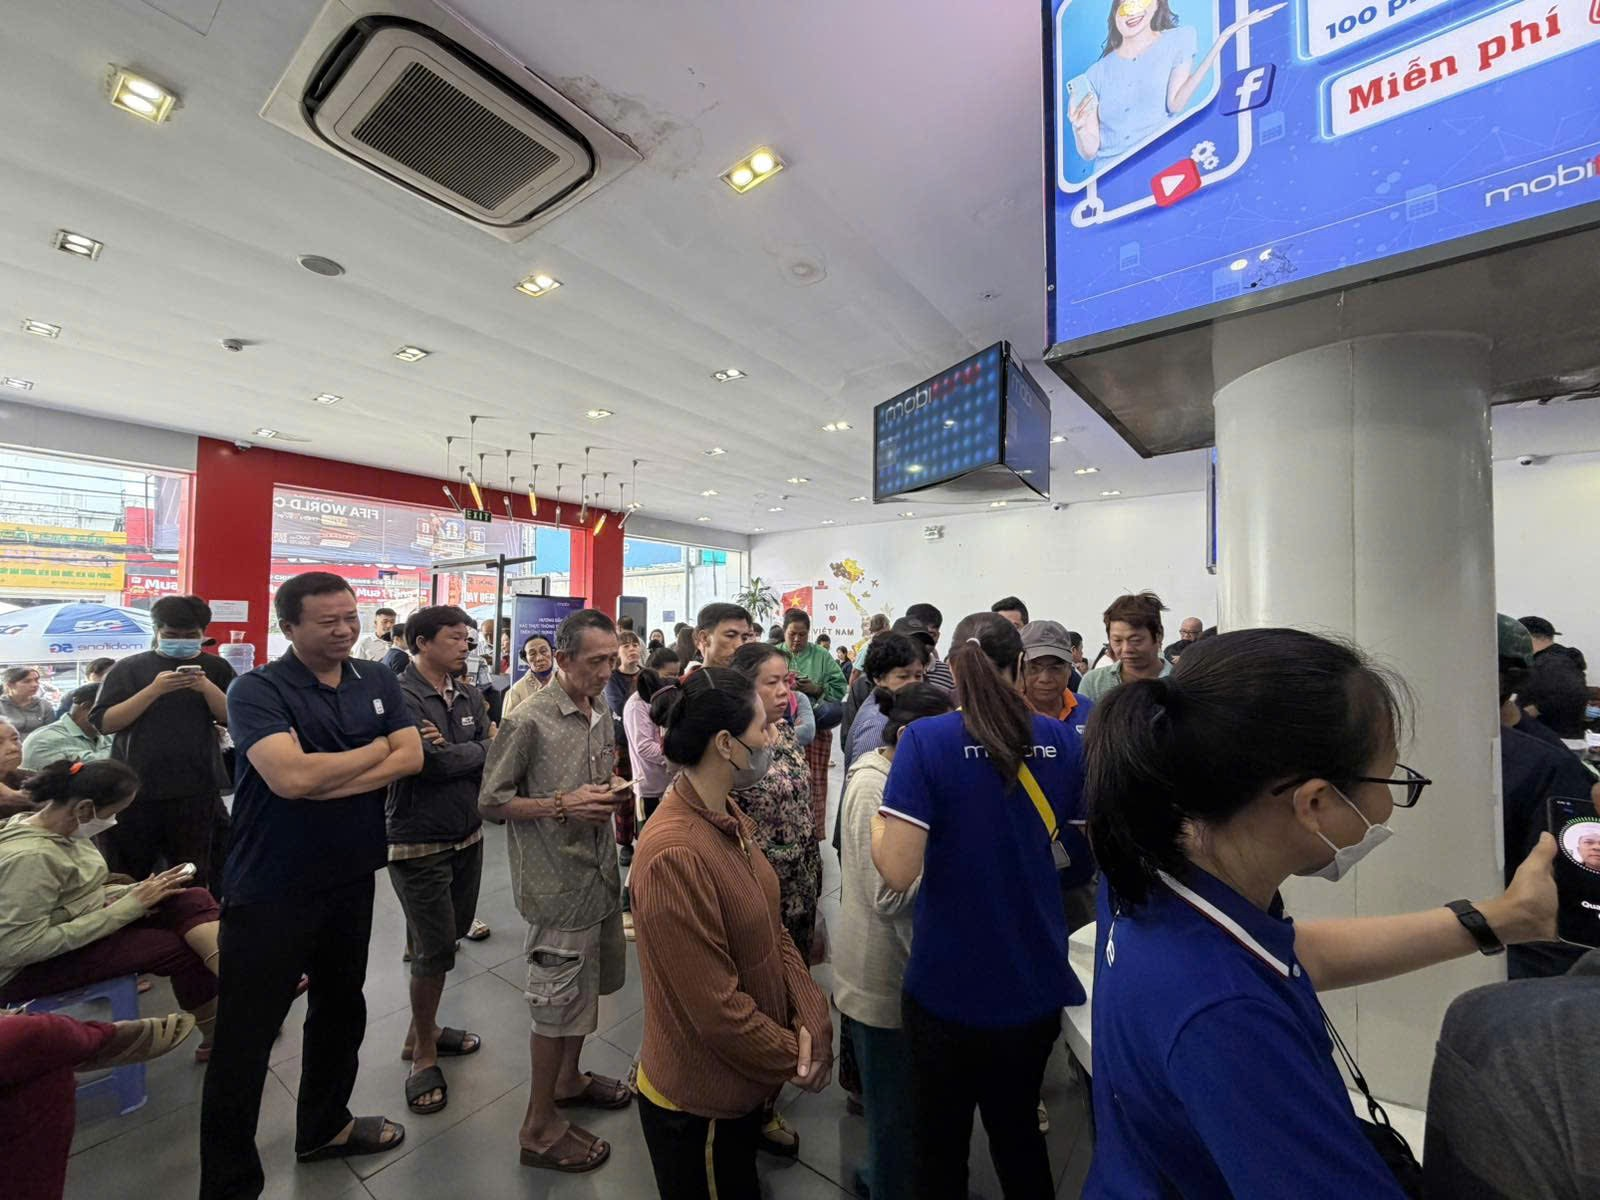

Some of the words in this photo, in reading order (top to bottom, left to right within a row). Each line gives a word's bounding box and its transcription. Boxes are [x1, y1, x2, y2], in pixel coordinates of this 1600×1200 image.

[1325, 6, 1377, 40] 100
[1348, 56, 1458, 115] Miễn
[1478, 5, 1561, 71] phí
[466, 510, 489, 521] EXIT
[145, 579, 178, 590] Mua
[824, 602, 838, 611] TÔI
[835, 628, 854, 636] NAM
